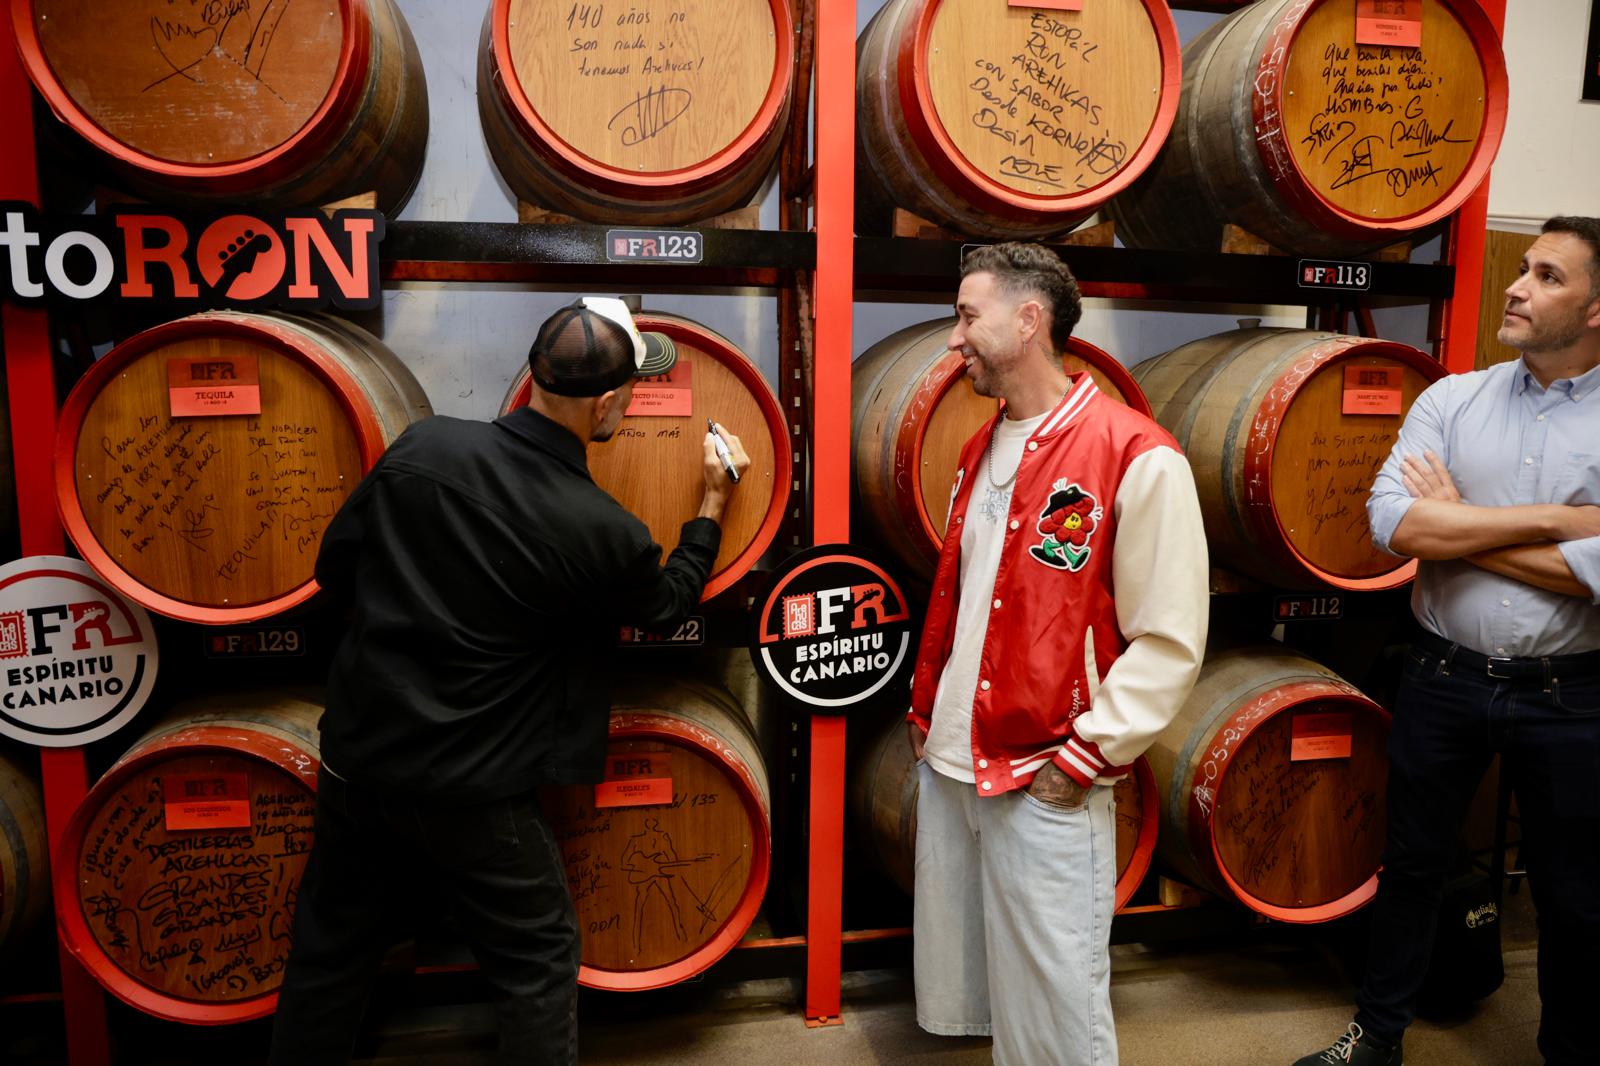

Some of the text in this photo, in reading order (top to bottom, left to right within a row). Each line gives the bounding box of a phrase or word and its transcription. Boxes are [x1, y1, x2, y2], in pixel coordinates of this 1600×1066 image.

[567, 3, 685, 30] 140 años no
[614, 35, 646, 51] nada
[1025, 31, 1067, 70] RON
[970, 77, 1018, 119] Desde
[1009, 78, 1065, 125] SABOR
[195, 391, 235, 400] TEQUILA
[796, 632, 884, 663] ESPÍRITU
[7, 655, 114, 687] ESPÍRITU
[790, 652, 890, 684] CANARIO
[3, 677, 124, 710] CANARIO
[691, 793, 719, 808] 135
[160, 853, 271, 877] AREHUCAS
[137, 868, 272, 912] GRANDES
[152, 889, 267, 927] GRANDES
